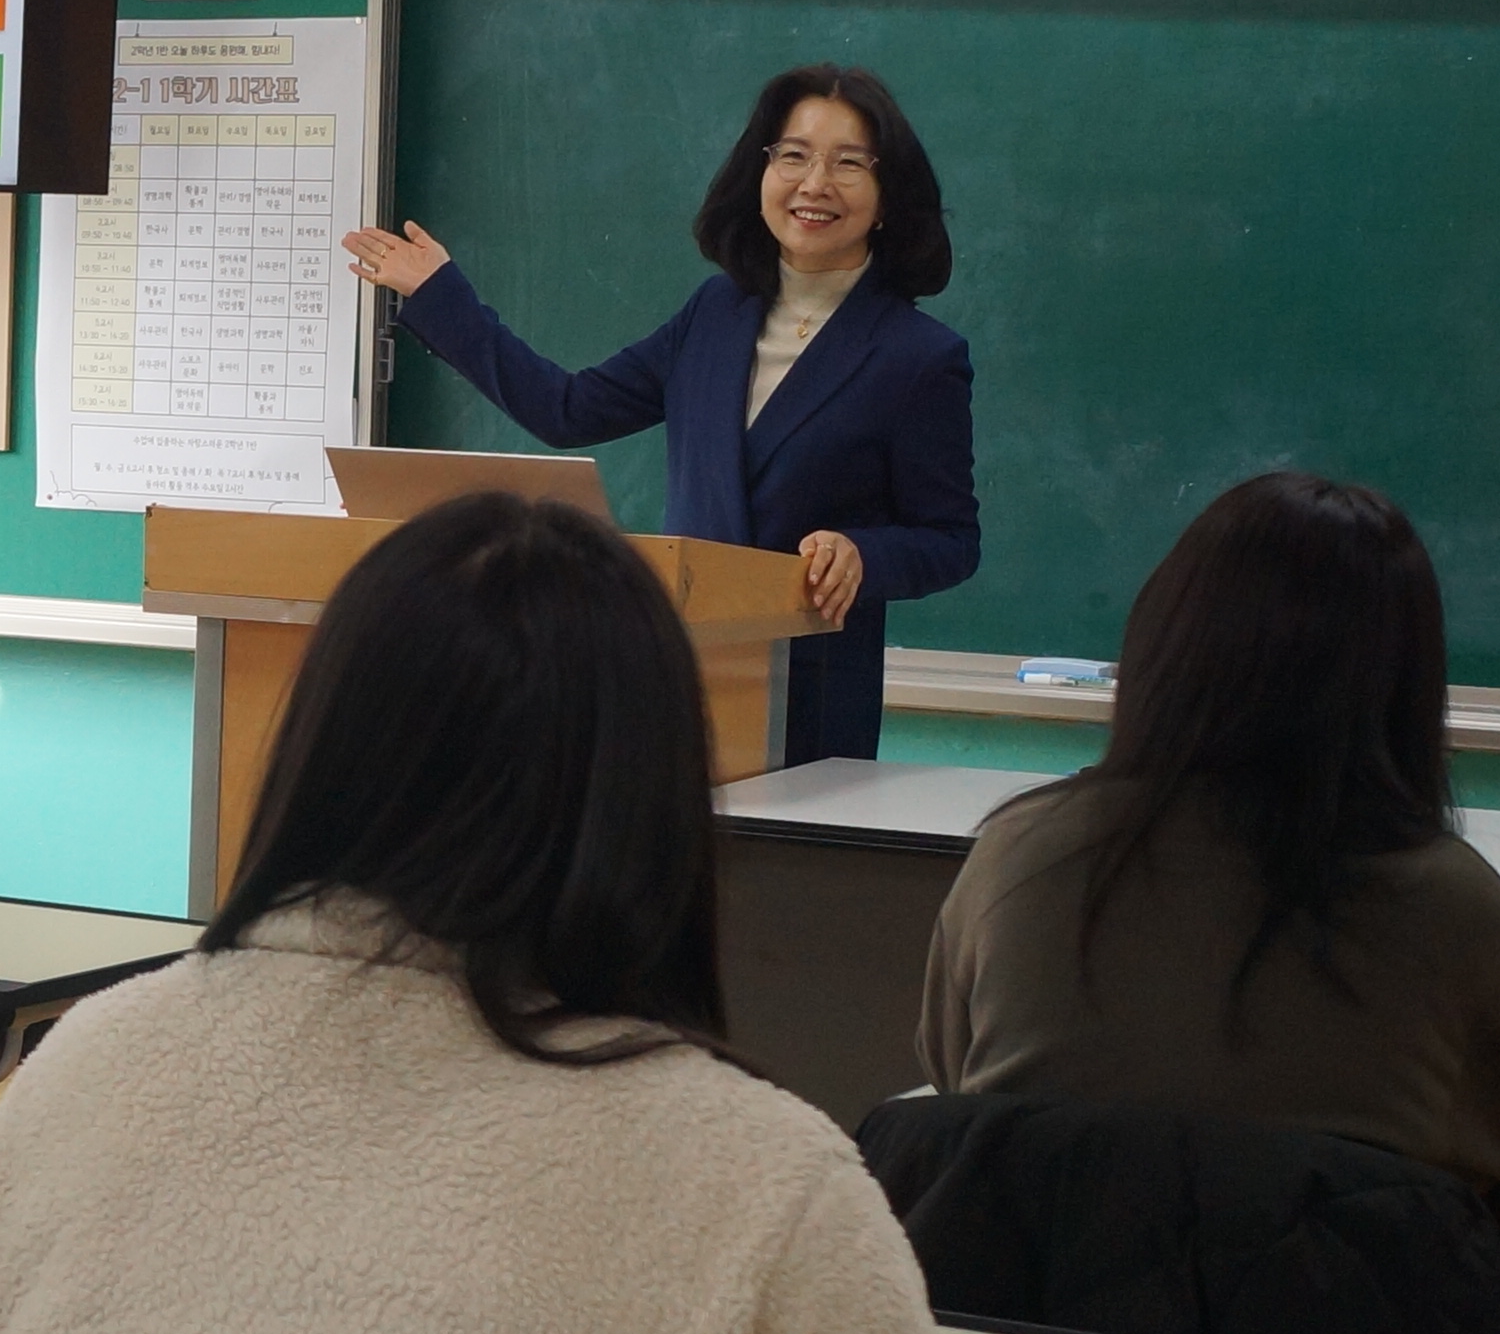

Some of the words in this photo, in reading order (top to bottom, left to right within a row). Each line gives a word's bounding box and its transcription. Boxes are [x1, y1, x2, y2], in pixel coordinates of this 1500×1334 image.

[113, 76, 151, 104] 2-1
[160, 75, 219, 104] 1학기
[225, 75, 300, 105] 시간표
